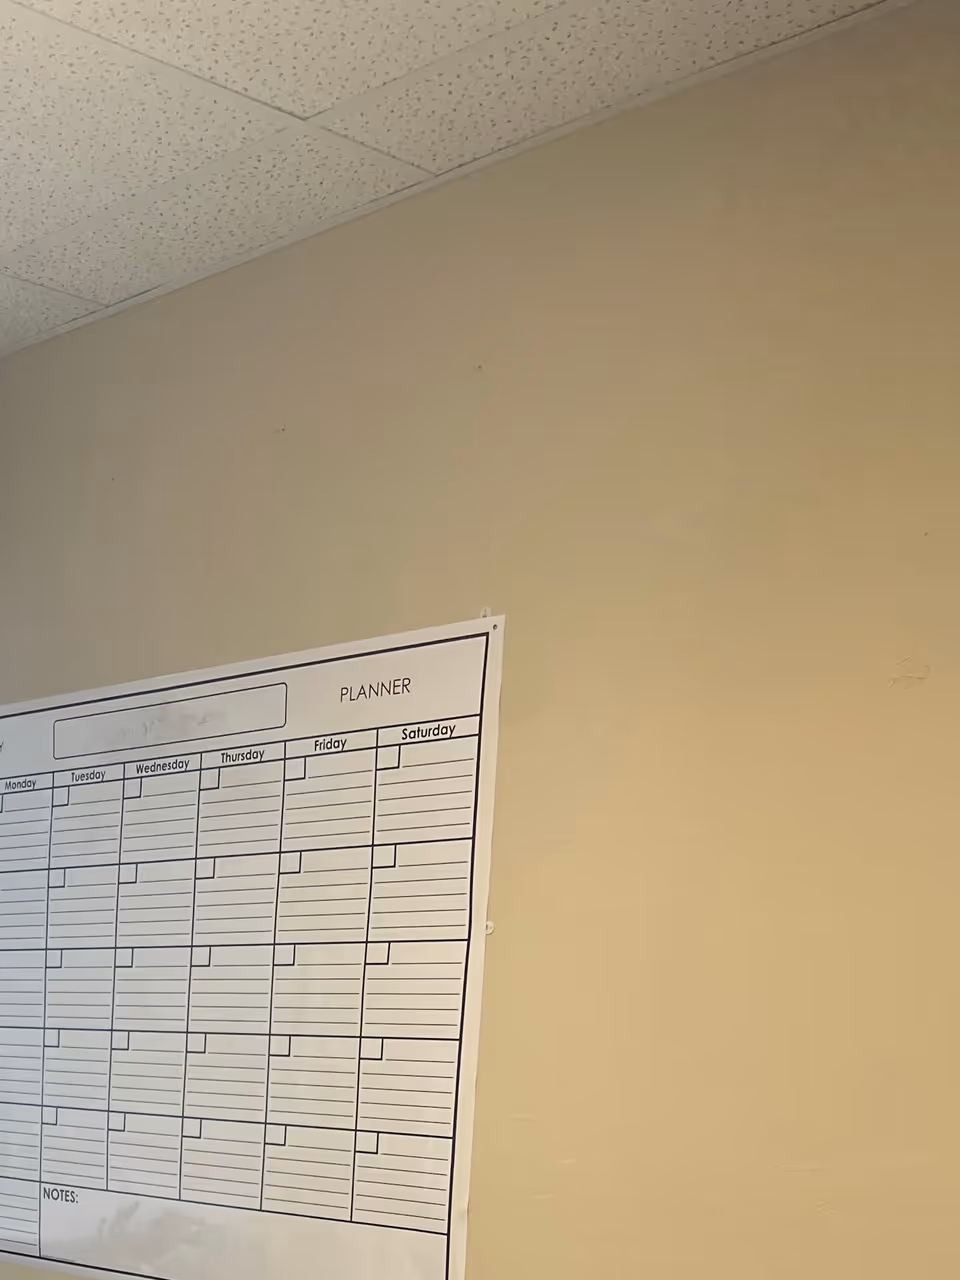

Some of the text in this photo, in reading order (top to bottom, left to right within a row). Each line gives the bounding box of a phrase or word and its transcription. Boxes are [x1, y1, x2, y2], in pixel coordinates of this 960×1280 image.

[340, 678, 411, 702] PLANNER
[401, 723, 456, 740] Saturday
[314, 737, 348, 752] Friday
[221, 749, 265, 764] Thursday
[135, 758, 190, 774] Wednesday
[71, 769, 106, 783] Tuesday
[5, 778, 37, 791] Monday
[43, 1187, 79, 1204] NOTES:
